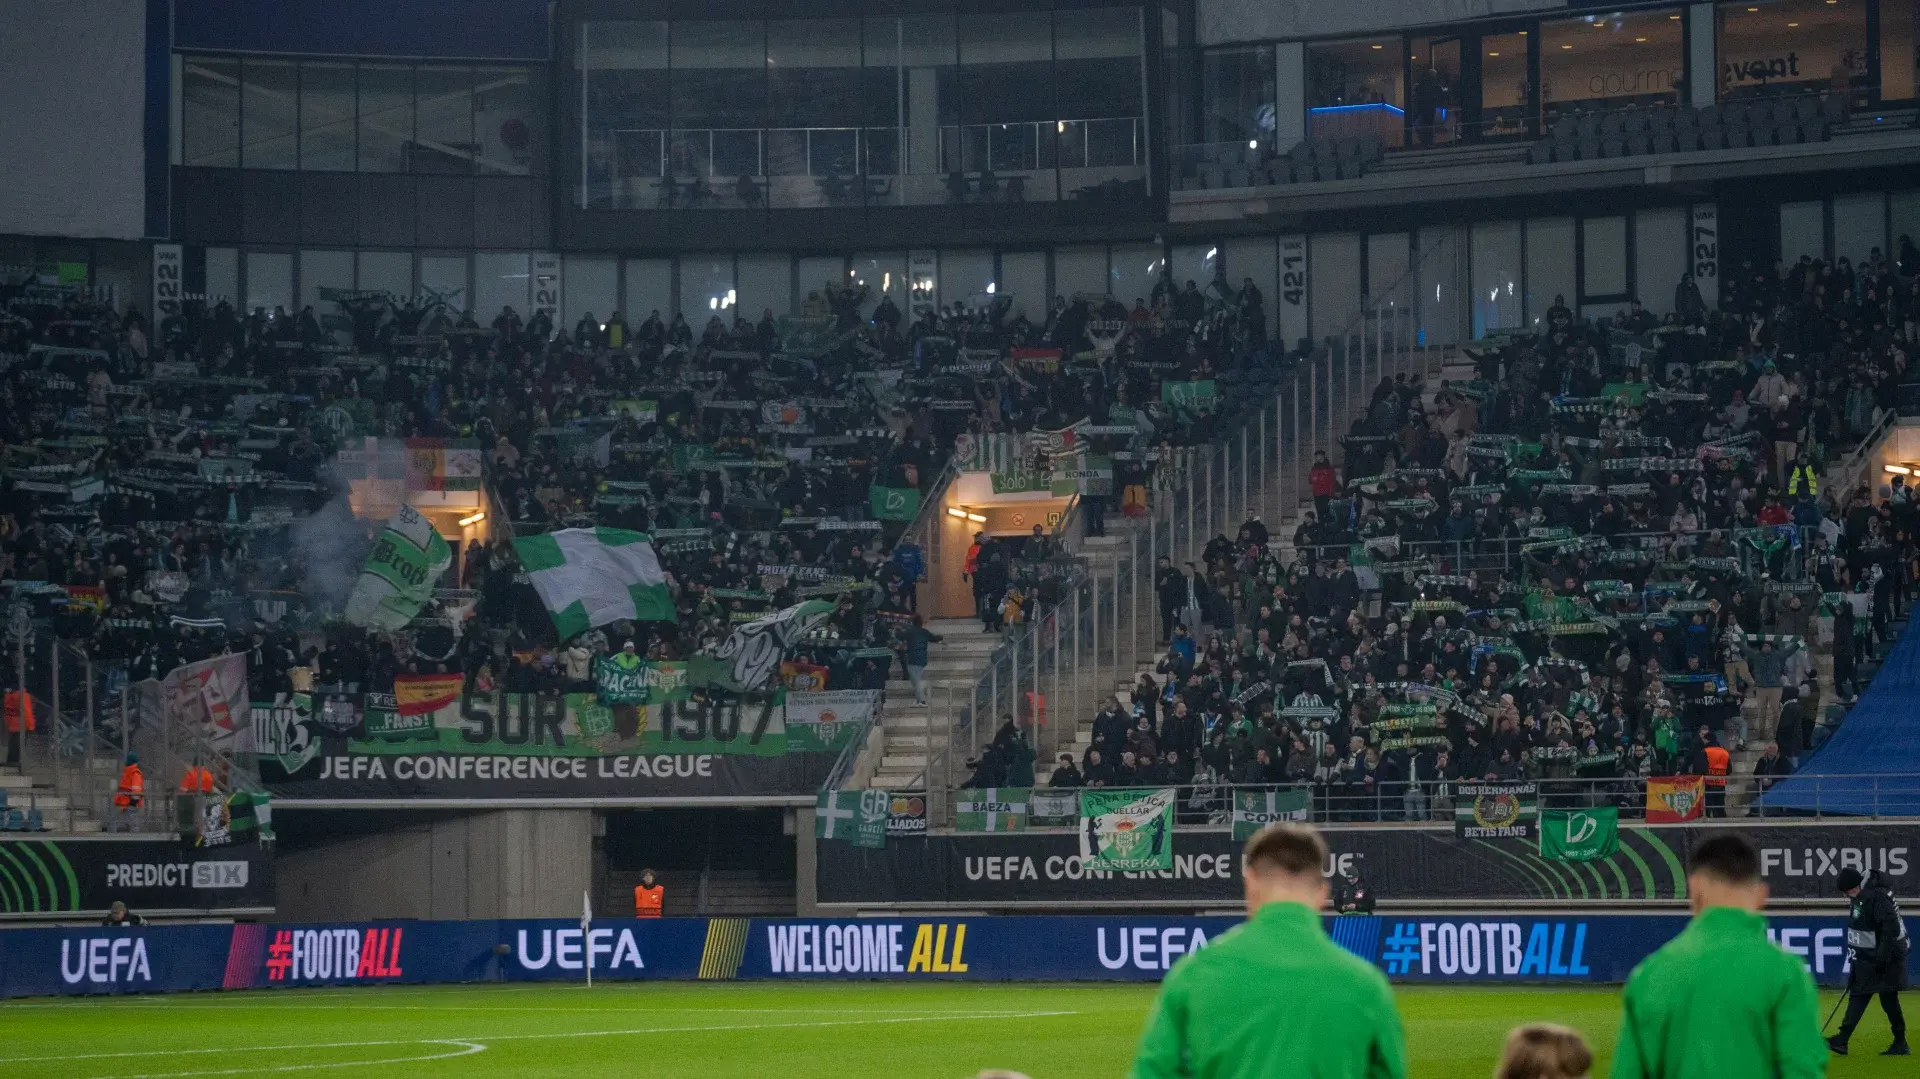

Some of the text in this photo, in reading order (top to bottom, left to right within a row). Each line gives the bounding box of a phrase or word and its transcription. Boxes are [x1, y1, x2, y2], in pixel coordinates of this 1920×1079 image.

[1694, 212, 1715, 220] VAK
[1695, 226, 1716, 278] 327
[157, 264, 180, 313] 422
[1283, 255, 1304, 306] 421
[1064, 470, 1099, 479] RONDA
[461, 693, 566, 746] SUR
[394, 756, 588, 780] CONFERENCE
[1458, 783, 1536, 796] DOS HERMANAS
[972, 802, 1012, 813] BAEZA
[1106, 806, 1150, 815] CUELLAR
[1244, 810, 1298, 823] CONIL
[1464, 826, 1527, 837] BETIS FANS
[106, 863, 243, 888] PREDICT SIX
[964, 855, 1038, 881] UEFA
[1091, 858, 1161, 868] HERRERA
[60, 937, 152, 984] UEFA
[266, 927, 404, 982] #FOOTBALL
[517, 928, 644, 970] UEFA
[767, 923, 969, 974] WELCOME ALL
[1382, 922, 1590, 976] #FOOTBALL
